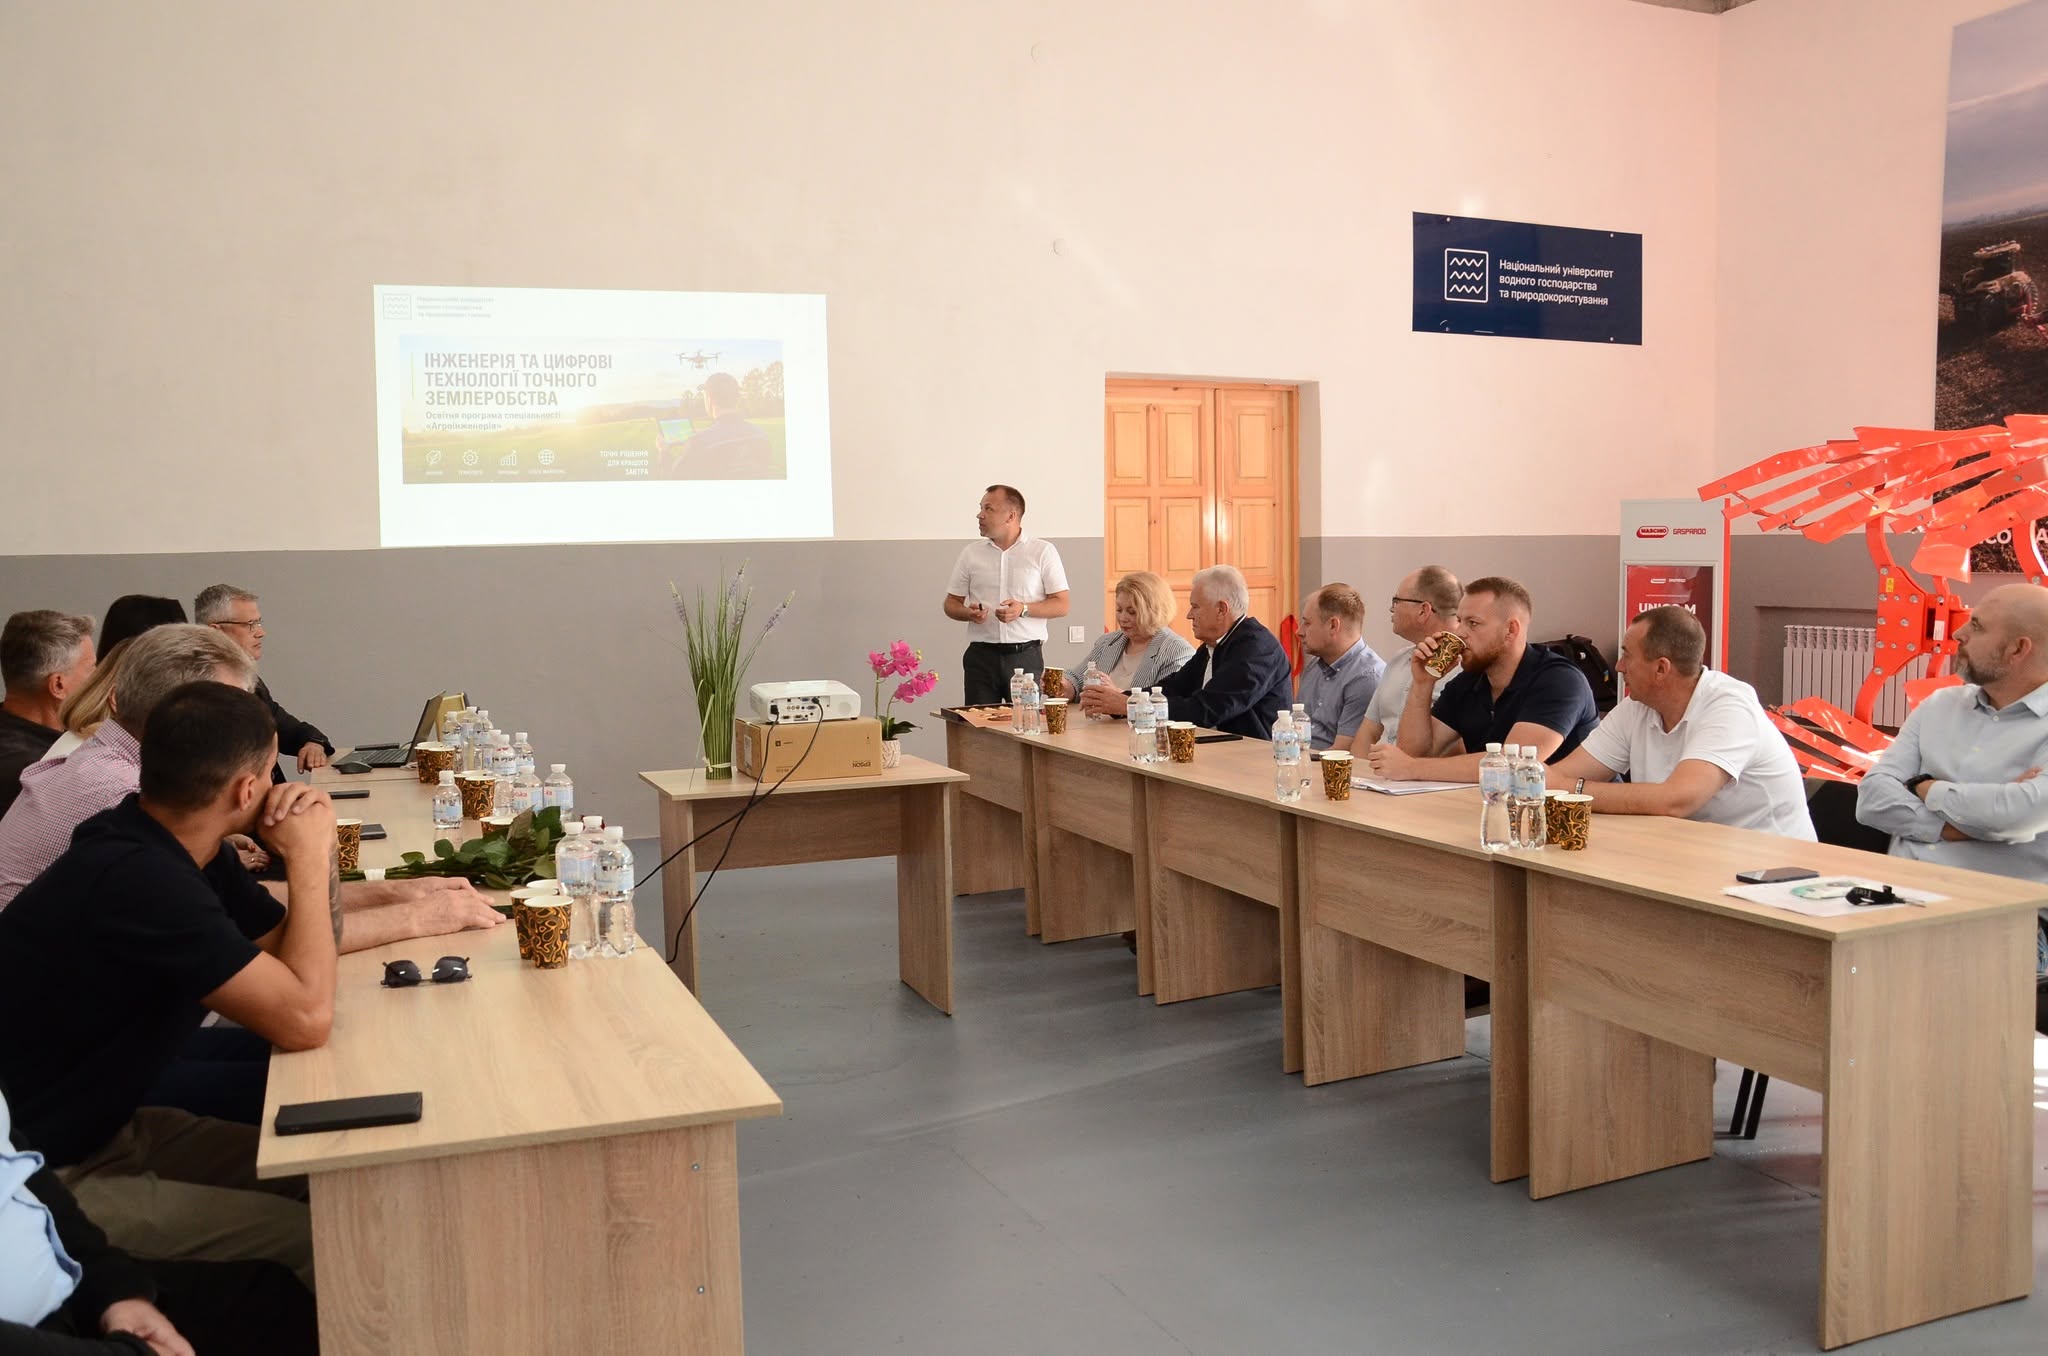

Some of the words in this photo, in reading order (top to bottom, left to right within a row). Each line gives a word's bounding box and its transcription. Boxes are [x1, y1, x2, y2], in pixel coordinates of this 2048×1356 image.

[1499, 259, 1560, 274] Національний
[1562, 266, 1614, 278] університет
[1499, 275, 1536, 286] водного
[1537, 278, 1598, 291] господарства
[1499, 289, 1509, 298] та
[1511, 290, 1608, 306] природокористування
[424, 352, 515, 369] ІНЖЕНЕРІЯ
[520, 353, 539, 369] ТА
[543, 353, 612, 371] ЦИФРОВІ
[424, 370, 518, 388] ТЕХНОЛОГІЇ
[522, 372, 597, 388] ТОЧНОГО
[425, 390, 559, 406] ЗЕМЛЕРОБСТВА
[425, 411, 459, 420] Освітня
[461, 412, 503, 422] програма
[504, 411, 561, 421] спеціальності
[426, 422, 502, 432] «Агроінженерія»
